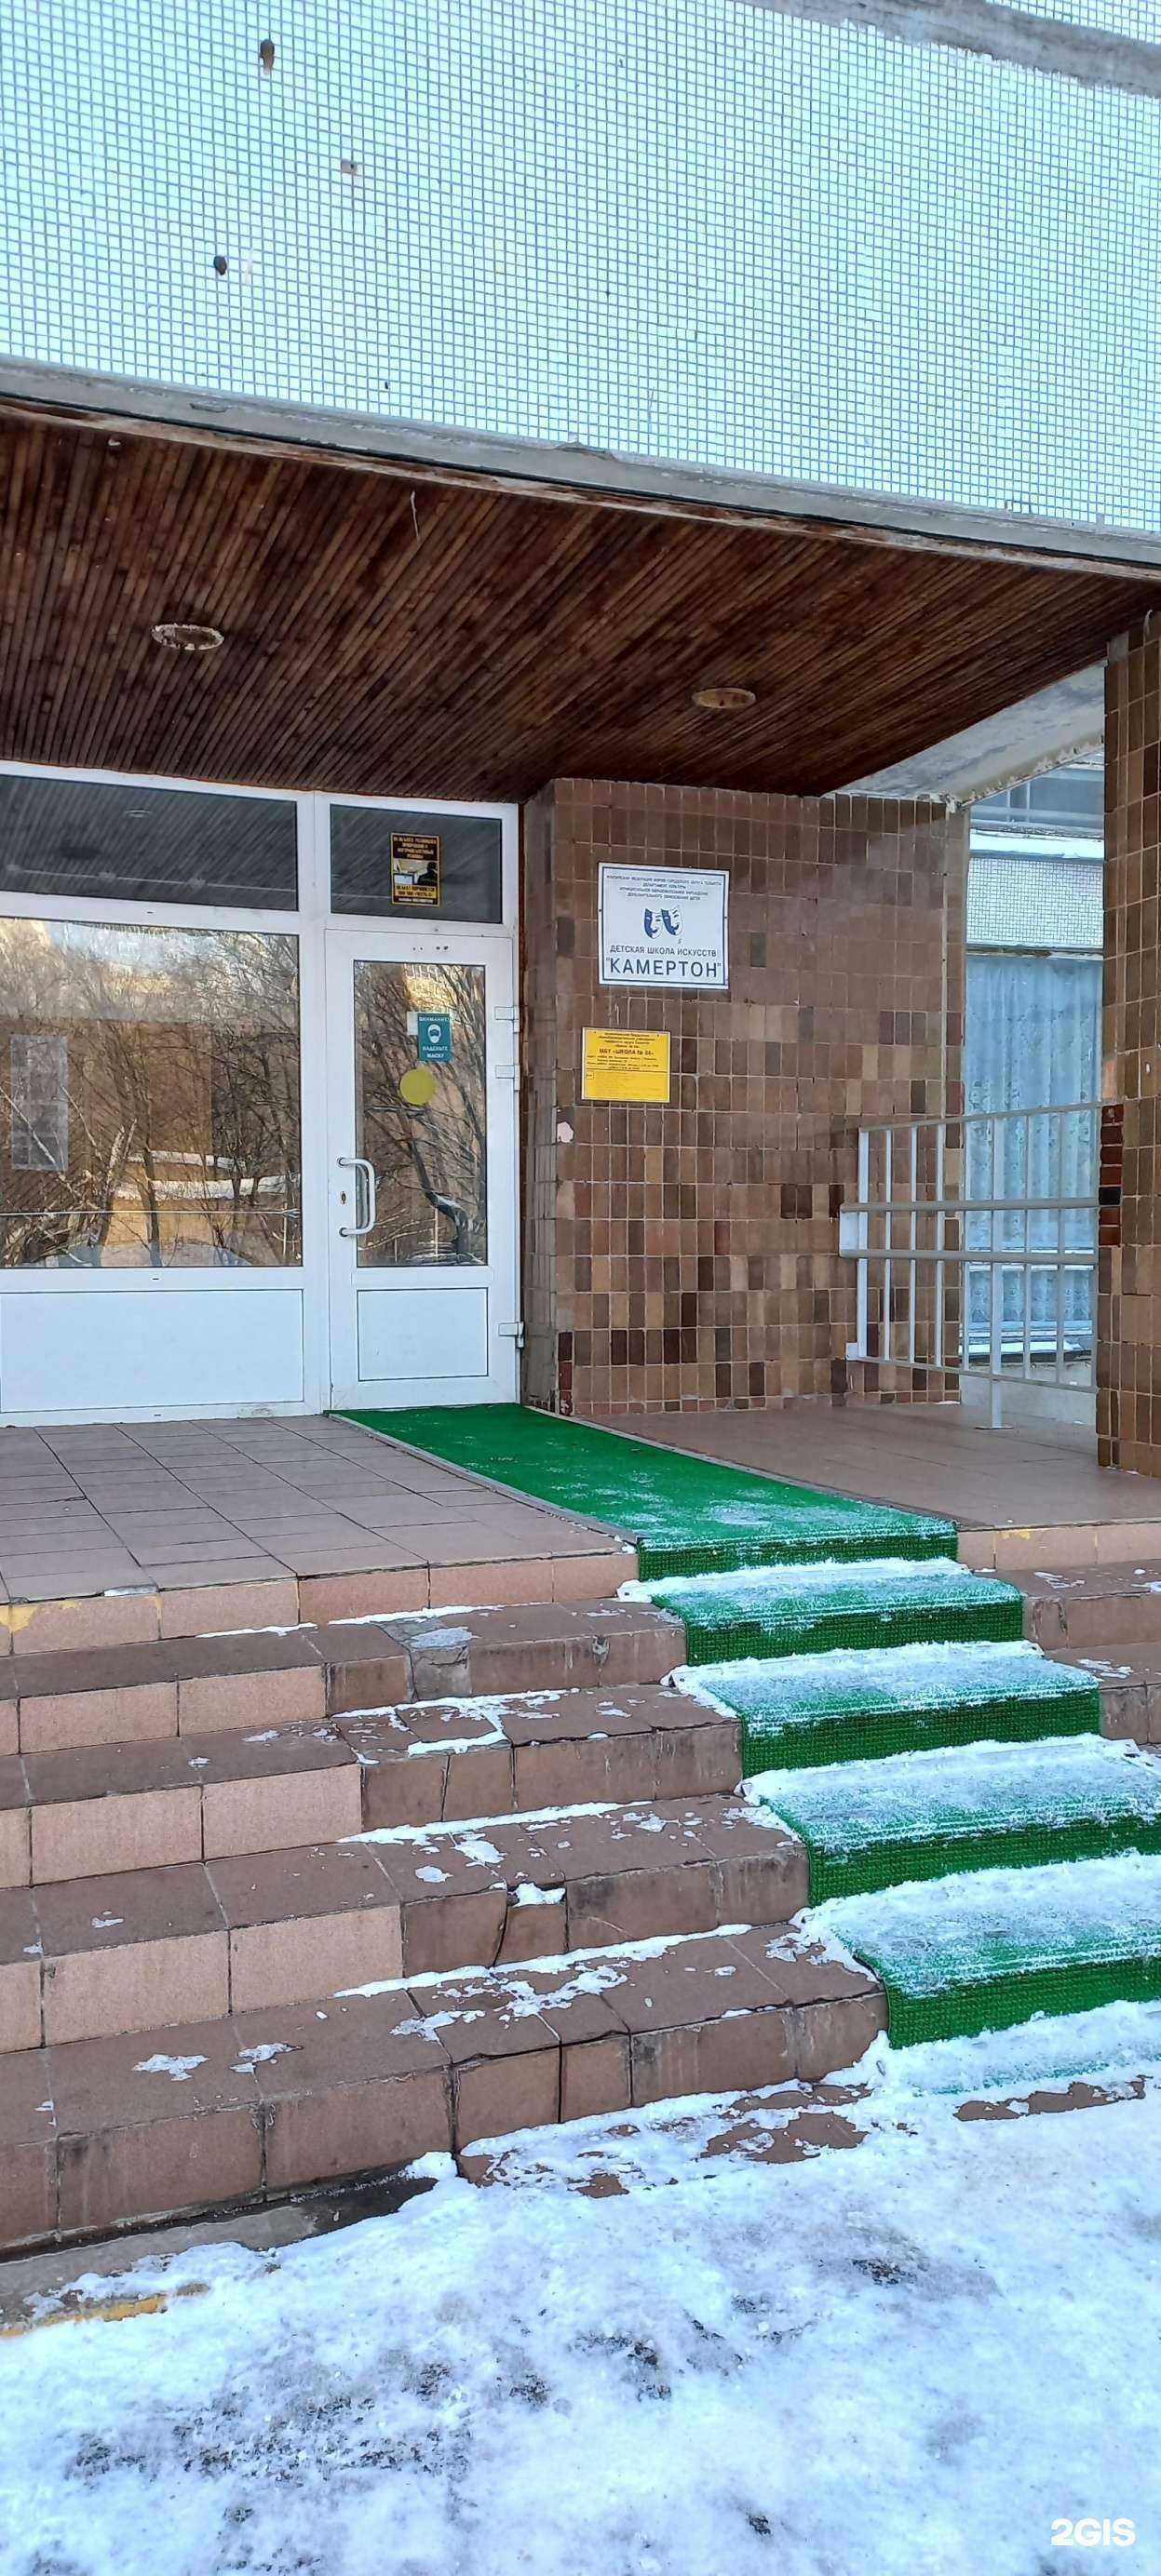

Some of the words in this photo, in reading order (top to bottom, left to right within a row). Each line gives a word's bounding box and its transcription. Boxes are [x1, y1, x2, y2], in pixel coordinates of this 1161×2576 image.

[610, 945, 645, 954] ДЕТСКАЯ
[647, 946, 675, 955] ШКОЛА
[677, 947, 717, 958] ИСКУССТВ
[606, 957, 722, 978] "КАМЕРТОН"
